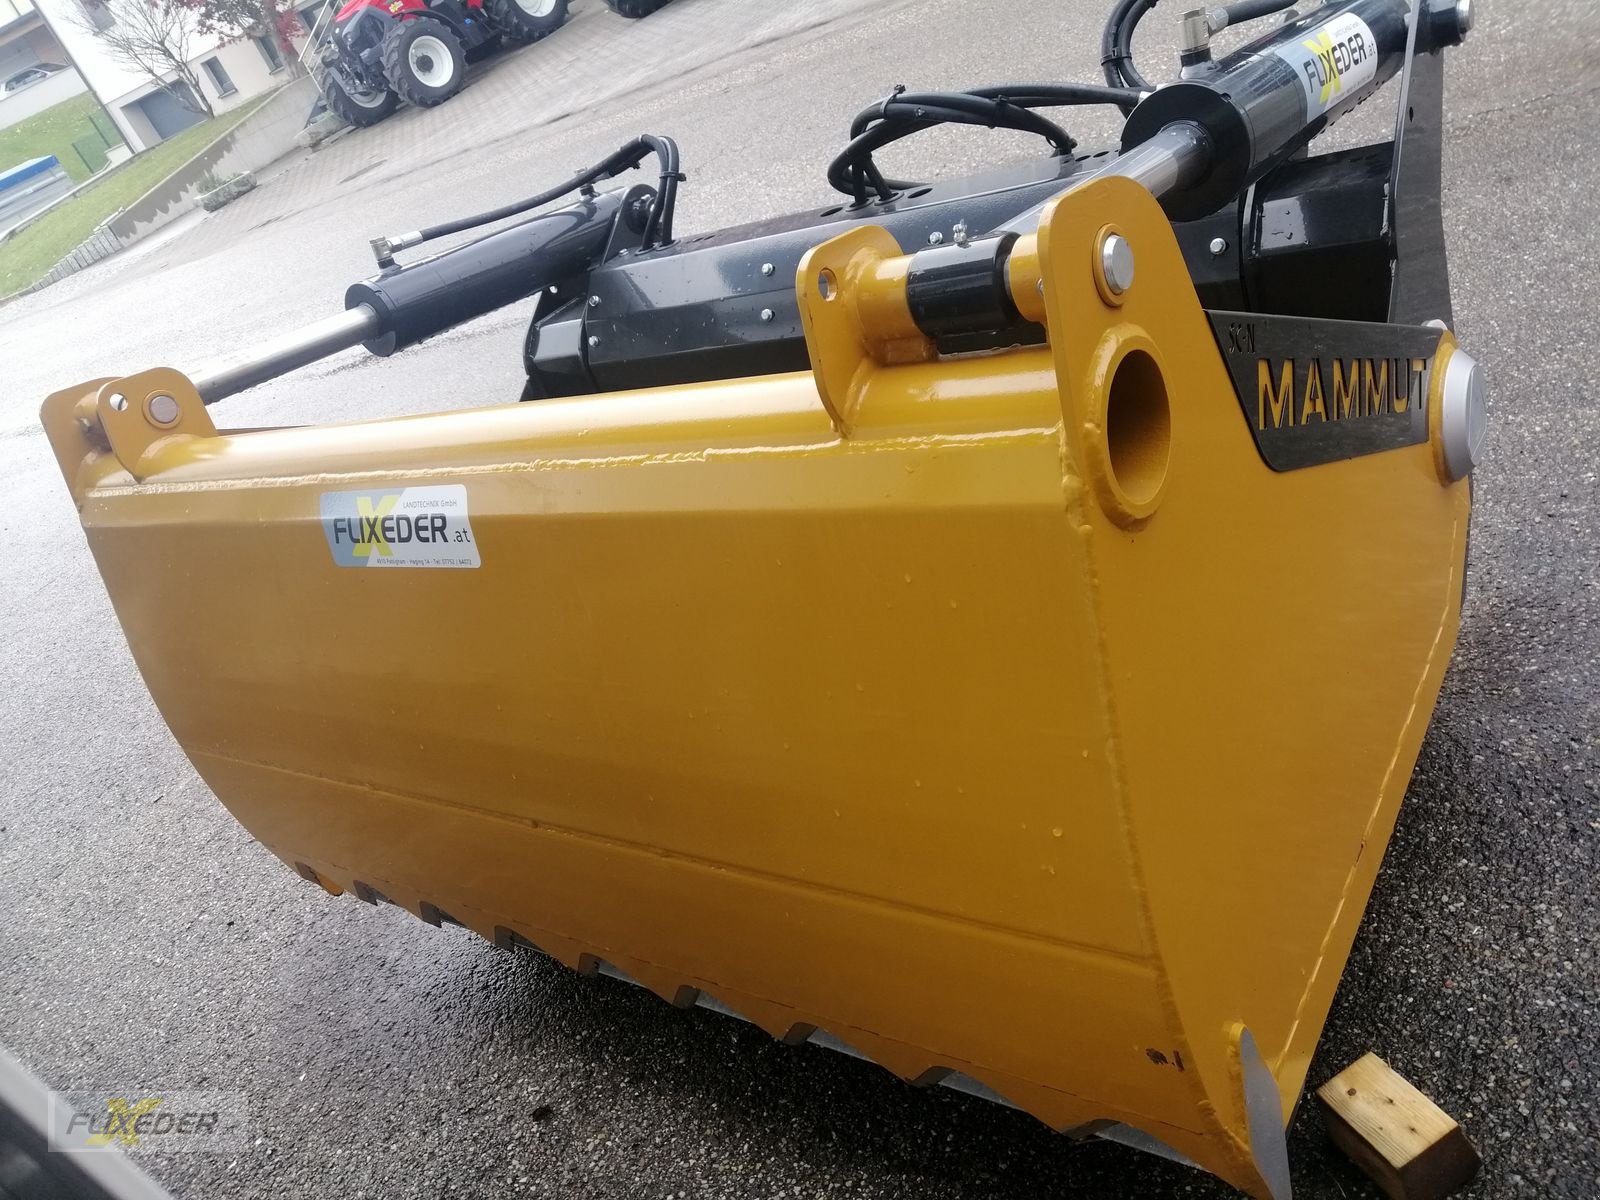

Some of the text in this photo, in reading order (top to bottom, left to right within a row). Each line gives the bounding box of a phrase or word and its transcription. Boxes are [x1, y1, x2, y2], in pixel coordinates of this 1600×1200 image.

[1303, 33, 1367, 93] FLIXEDER
[1257, 358, 1426, 431] MAMMUT
[403, 500, 439, 509] LANDTECHNIK
[333, 513, 471, 544] FLIXEDER .at
